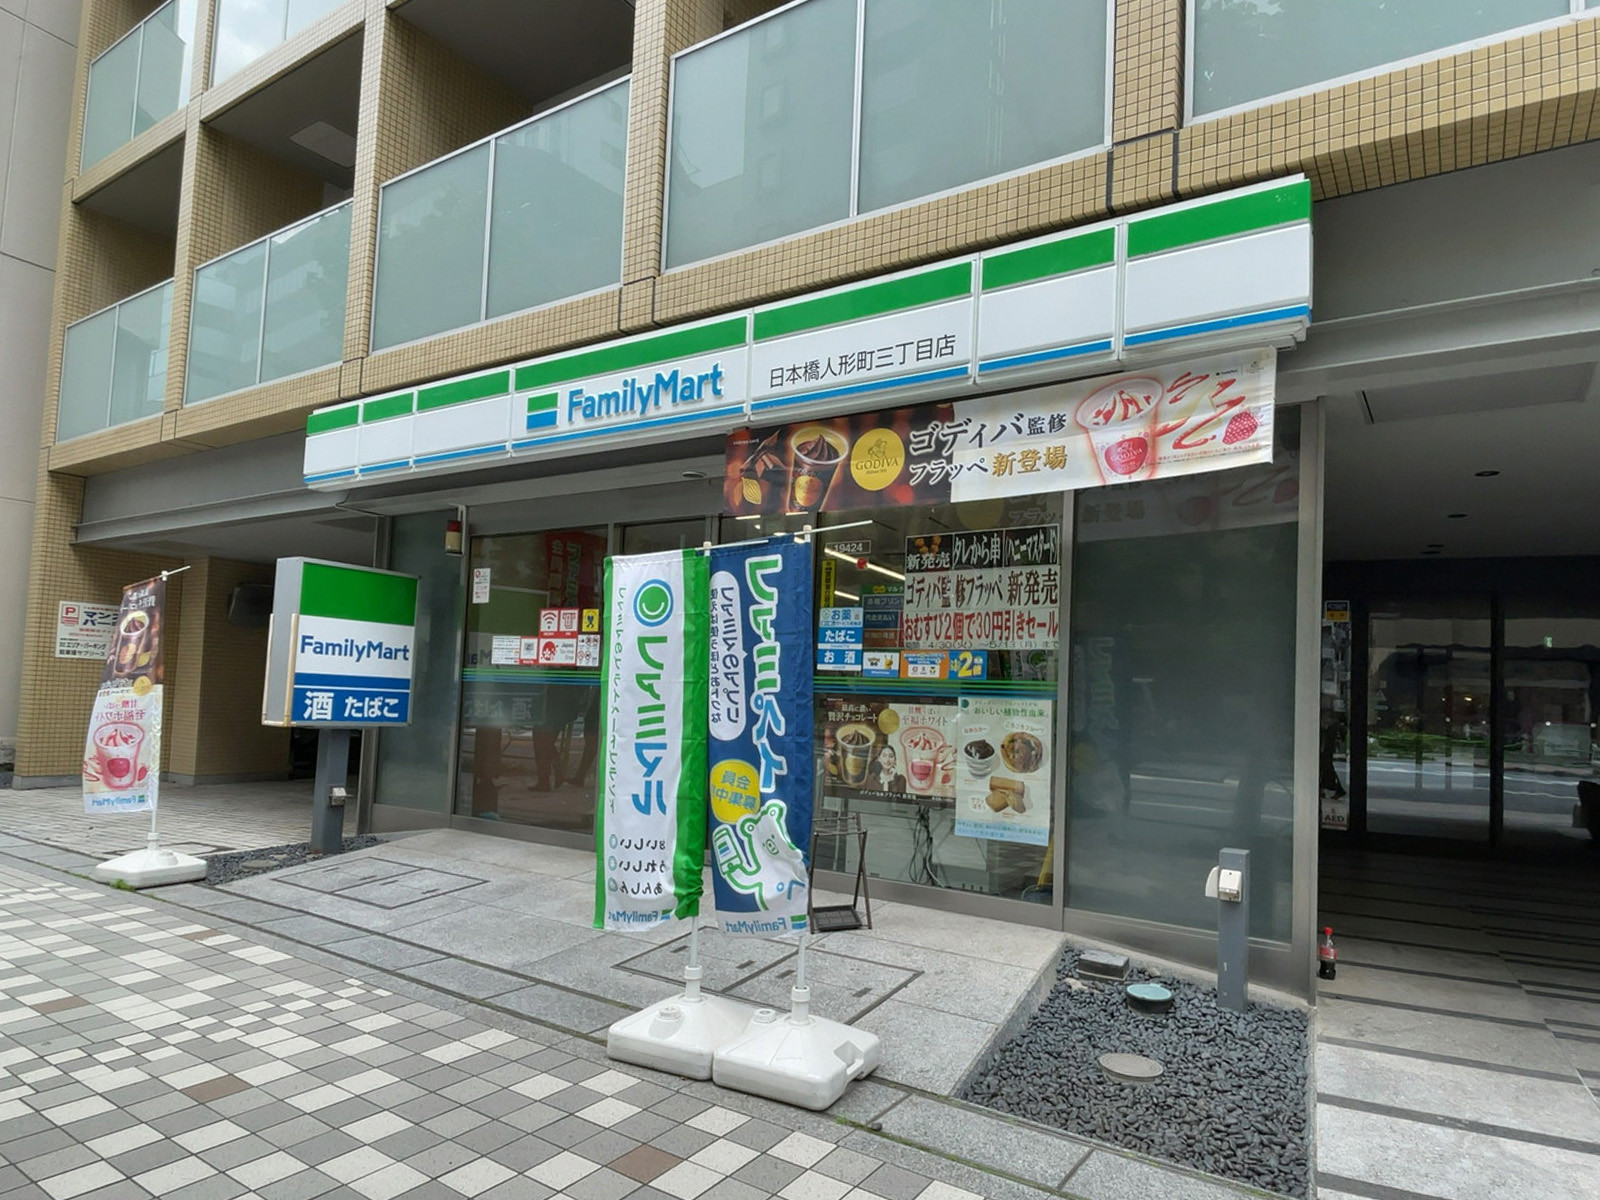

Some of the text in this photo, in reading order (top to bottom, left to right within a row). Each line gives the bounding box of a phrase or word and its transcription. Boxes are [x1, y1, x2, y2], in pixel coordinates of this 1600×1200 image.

[770, 334, 956, 388] 日本橋人形町三丁目店
[568, 362, 724, 423] FamilyMart
[910, 413, 1067, 455] ゴディバ監修
[855, 457, 899, 471] GODIVA
[834, 543, 863, 553] 19424
[907, 552, 950, 570] 新発売
[1007, 568, 1058, 606] 新発売
[825, 629, 856, 643] たばこ
[904, 610, 1059, 642] おむすび2個で30円引きセール
[300, 635, 409, 662] FamilyMart
[303, 691, 399, 720] 酒 たばこ
